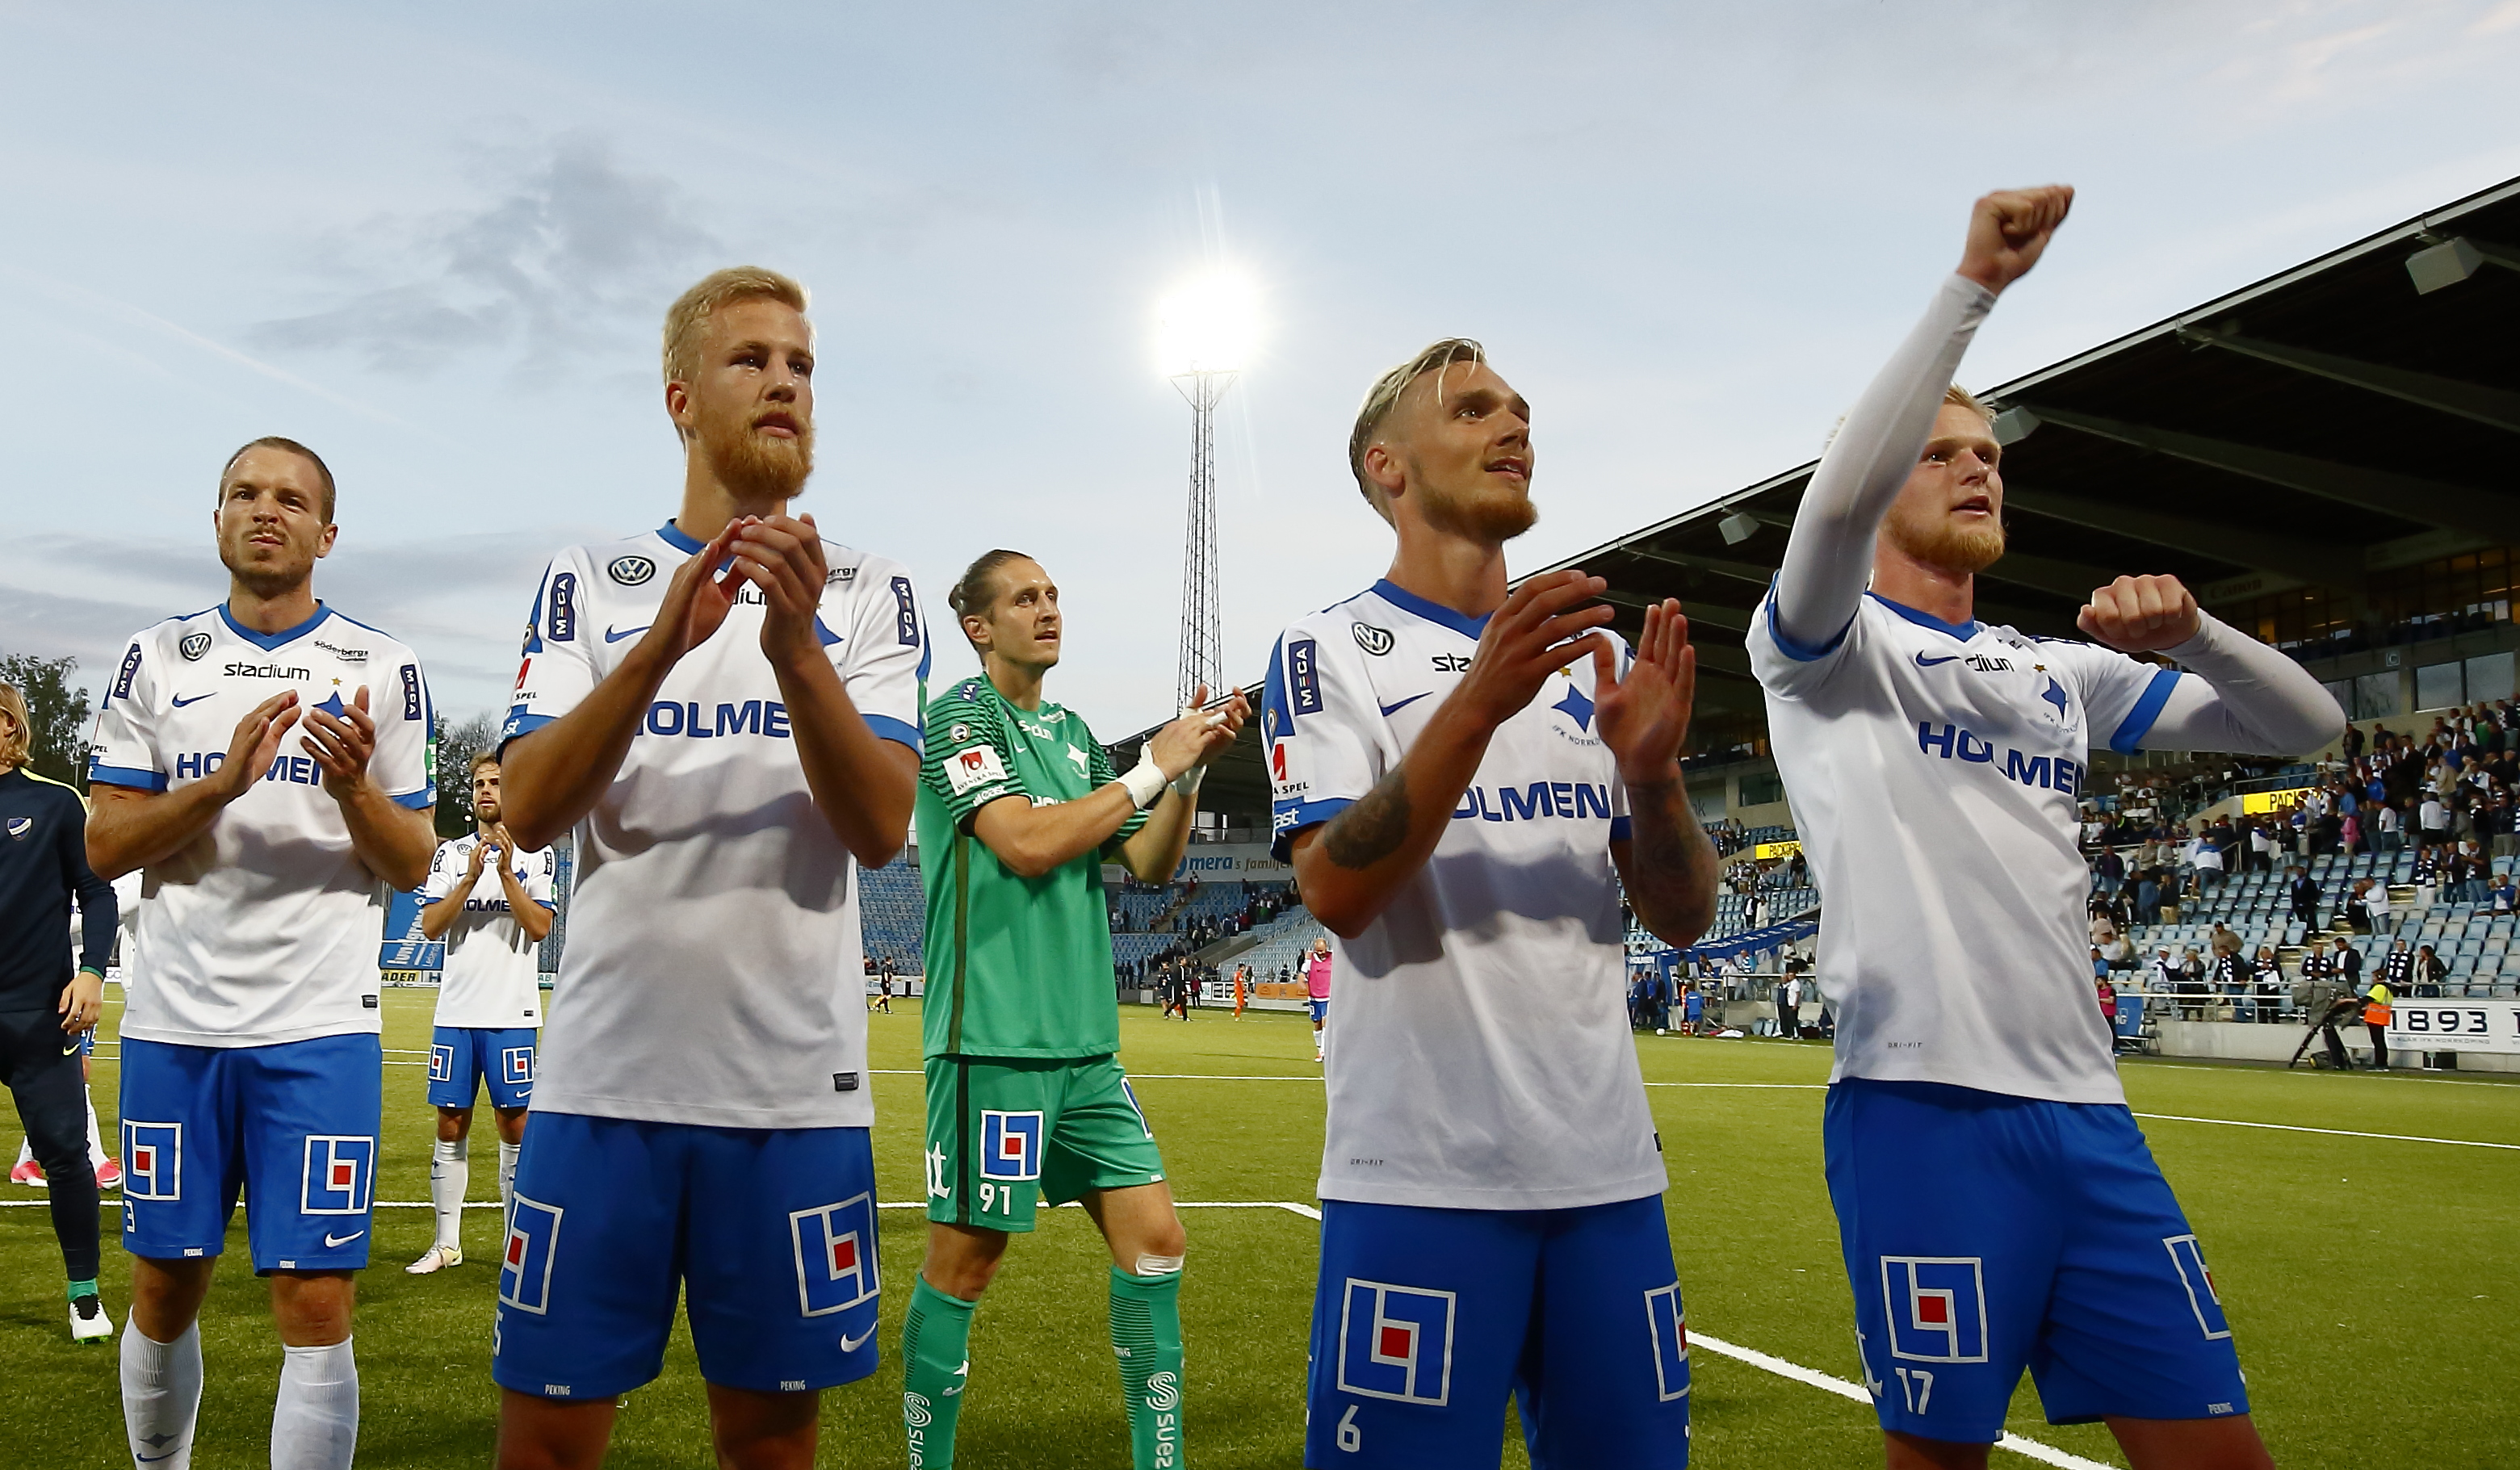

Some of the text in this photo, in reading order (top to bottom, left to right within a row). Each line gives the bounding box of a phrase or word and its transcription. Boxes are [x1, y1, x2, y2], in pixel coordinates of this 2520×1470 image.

[2210, 579, 2262, 598] Canon
[223, 661, 311, 681] stadium
[1296, 647, 1314, 708] MECA
[515, 691, 538, 701] SPEL
[635, 699, 790, 738] OLME
[1553, 724, 1566, 738] IFK
[1282, 781, 1310, 794] SPEL
[1451, 781, 1612, 823] OLMEN
[1189, 855, 1234, 870] mera
[2391, 1010, 2488, 1032] 1893
[979, 1183, 1011, 1216] 91
[545, 1384, 571, 1396] PEKING
[780, 1380, 806, 1391] PEKING
[1895, 1367, 1934, 1415] 17
[1336, 1405, 1361, 1453] 6
[1155, 1413, 1176, 1470] suez
